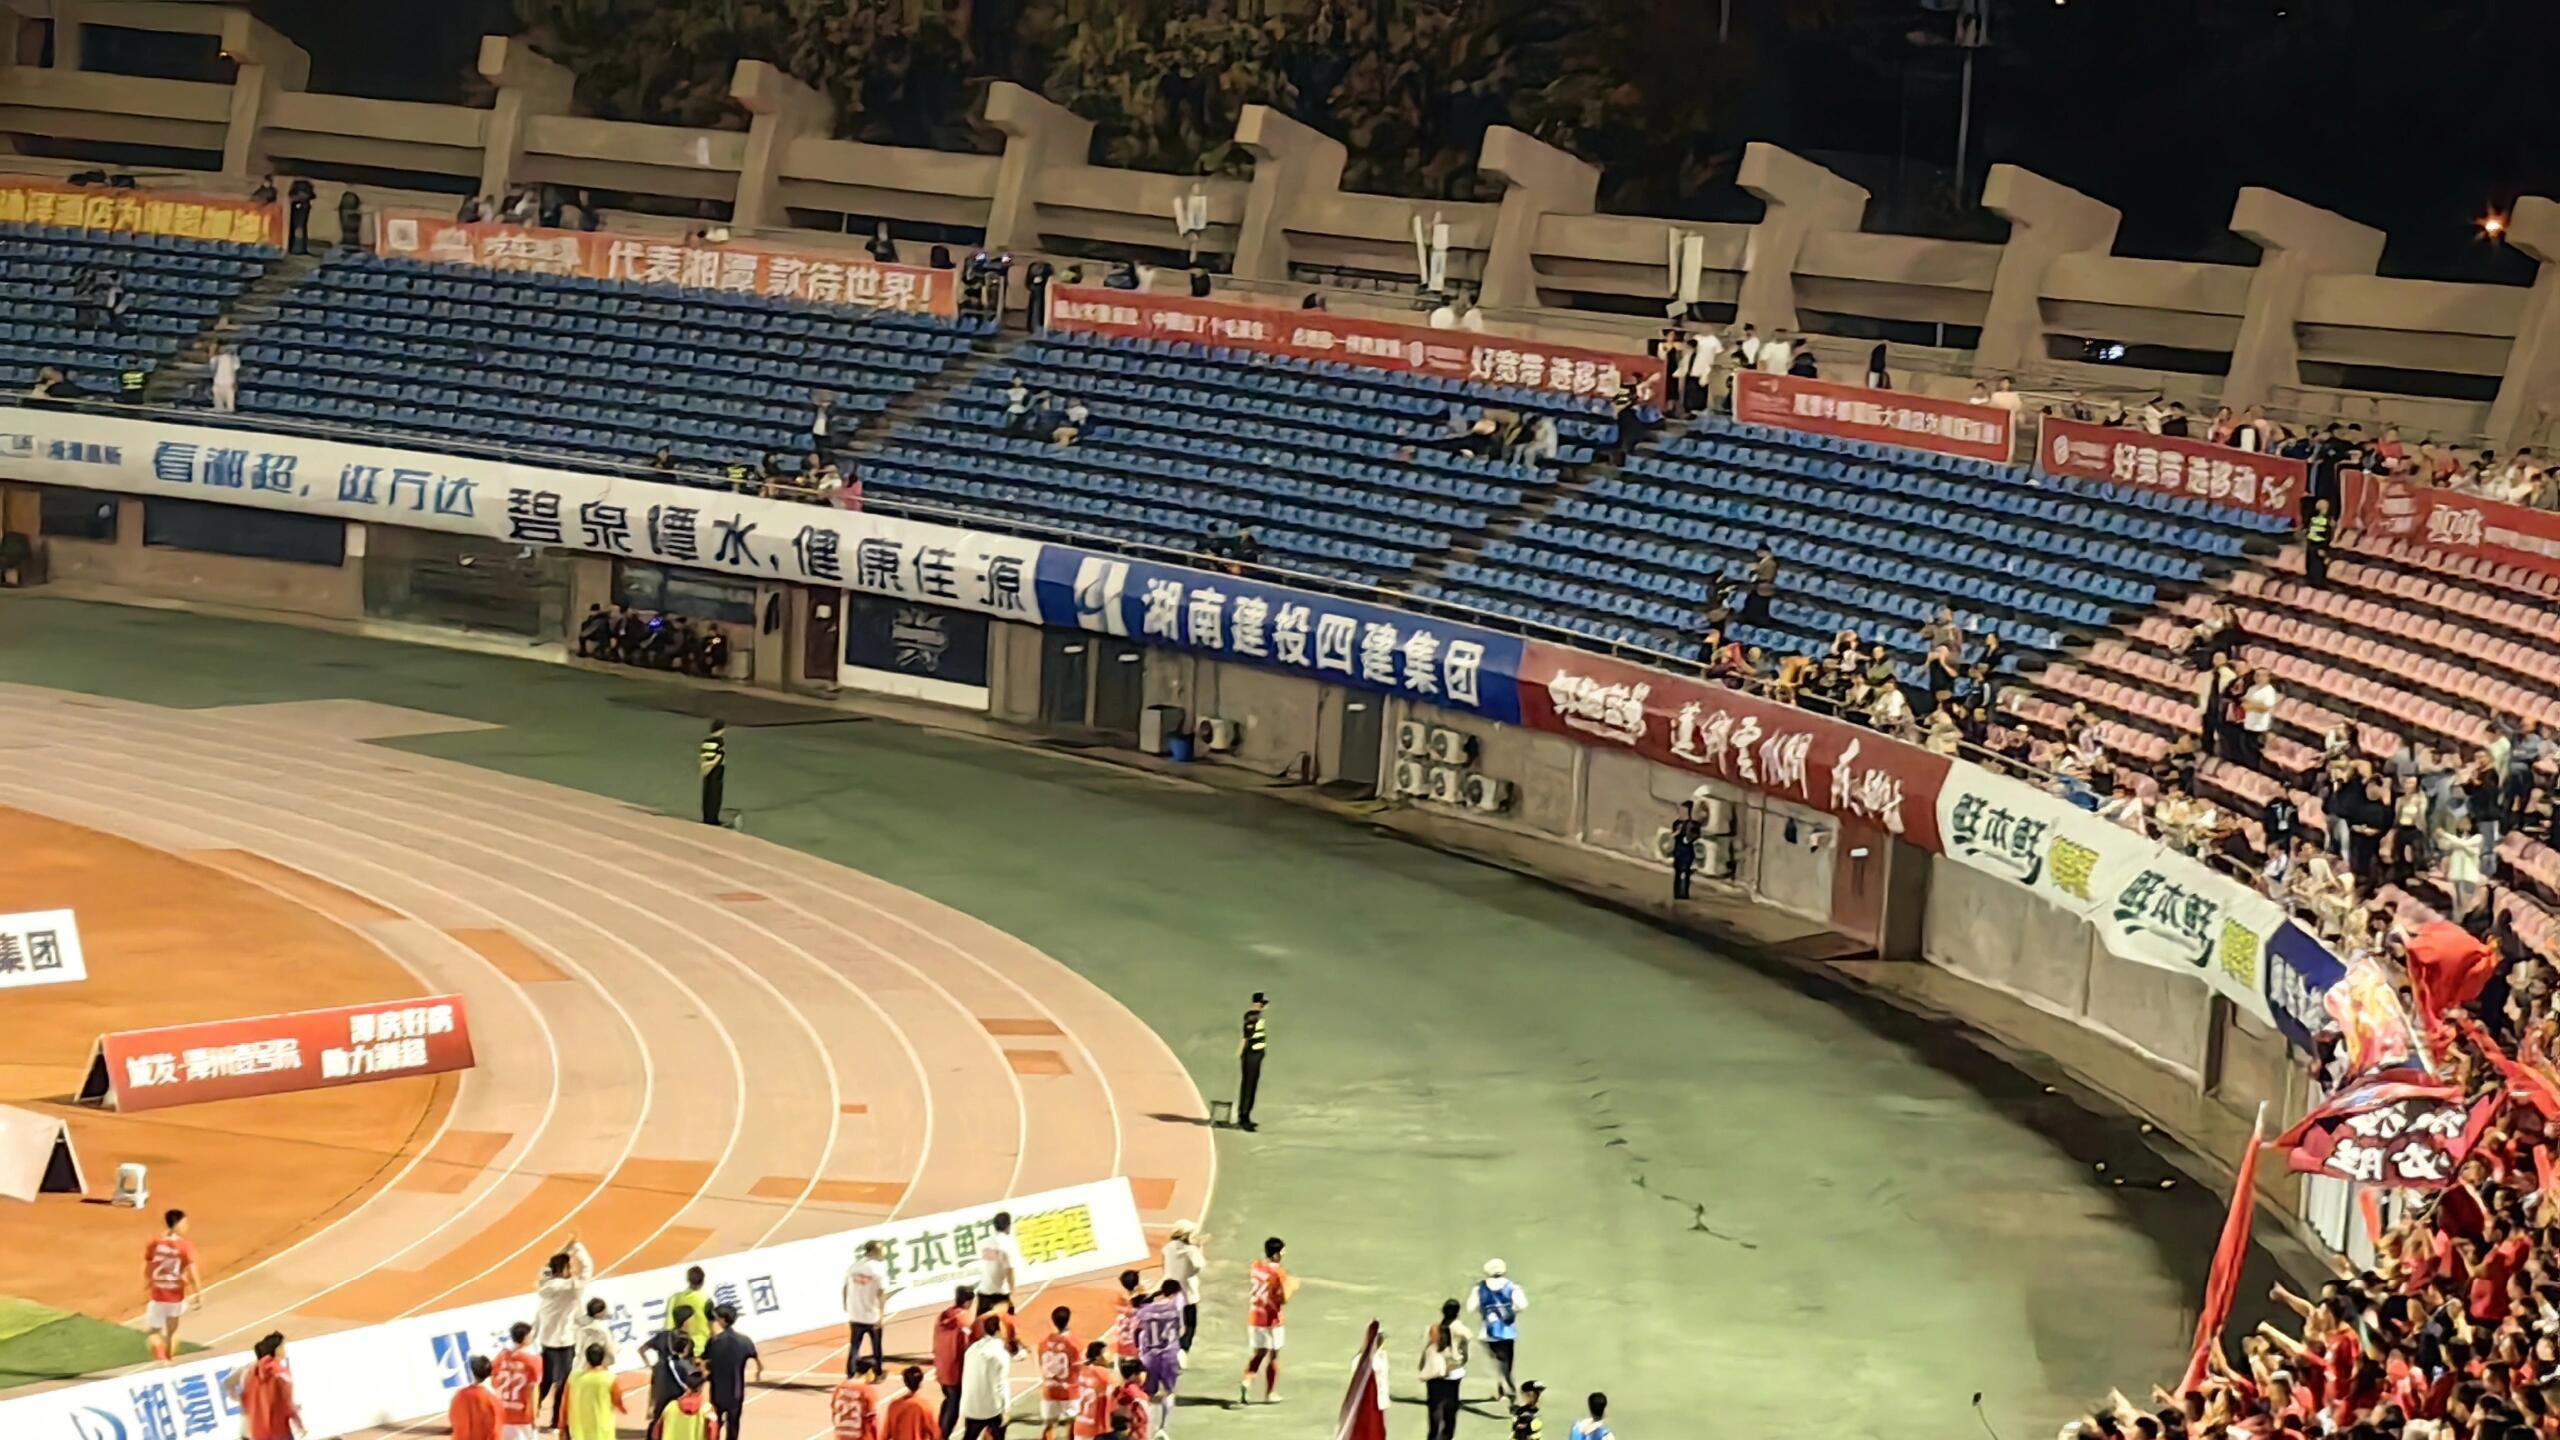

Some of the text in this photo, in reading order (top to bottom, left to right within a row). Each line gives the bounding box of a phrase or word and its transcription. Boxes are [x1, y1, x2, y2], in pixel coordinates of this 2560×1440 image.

[608, 240, 757, 293] 代表湘潭
[1142, 577, 1485, 706] 湖南建投四建集团
